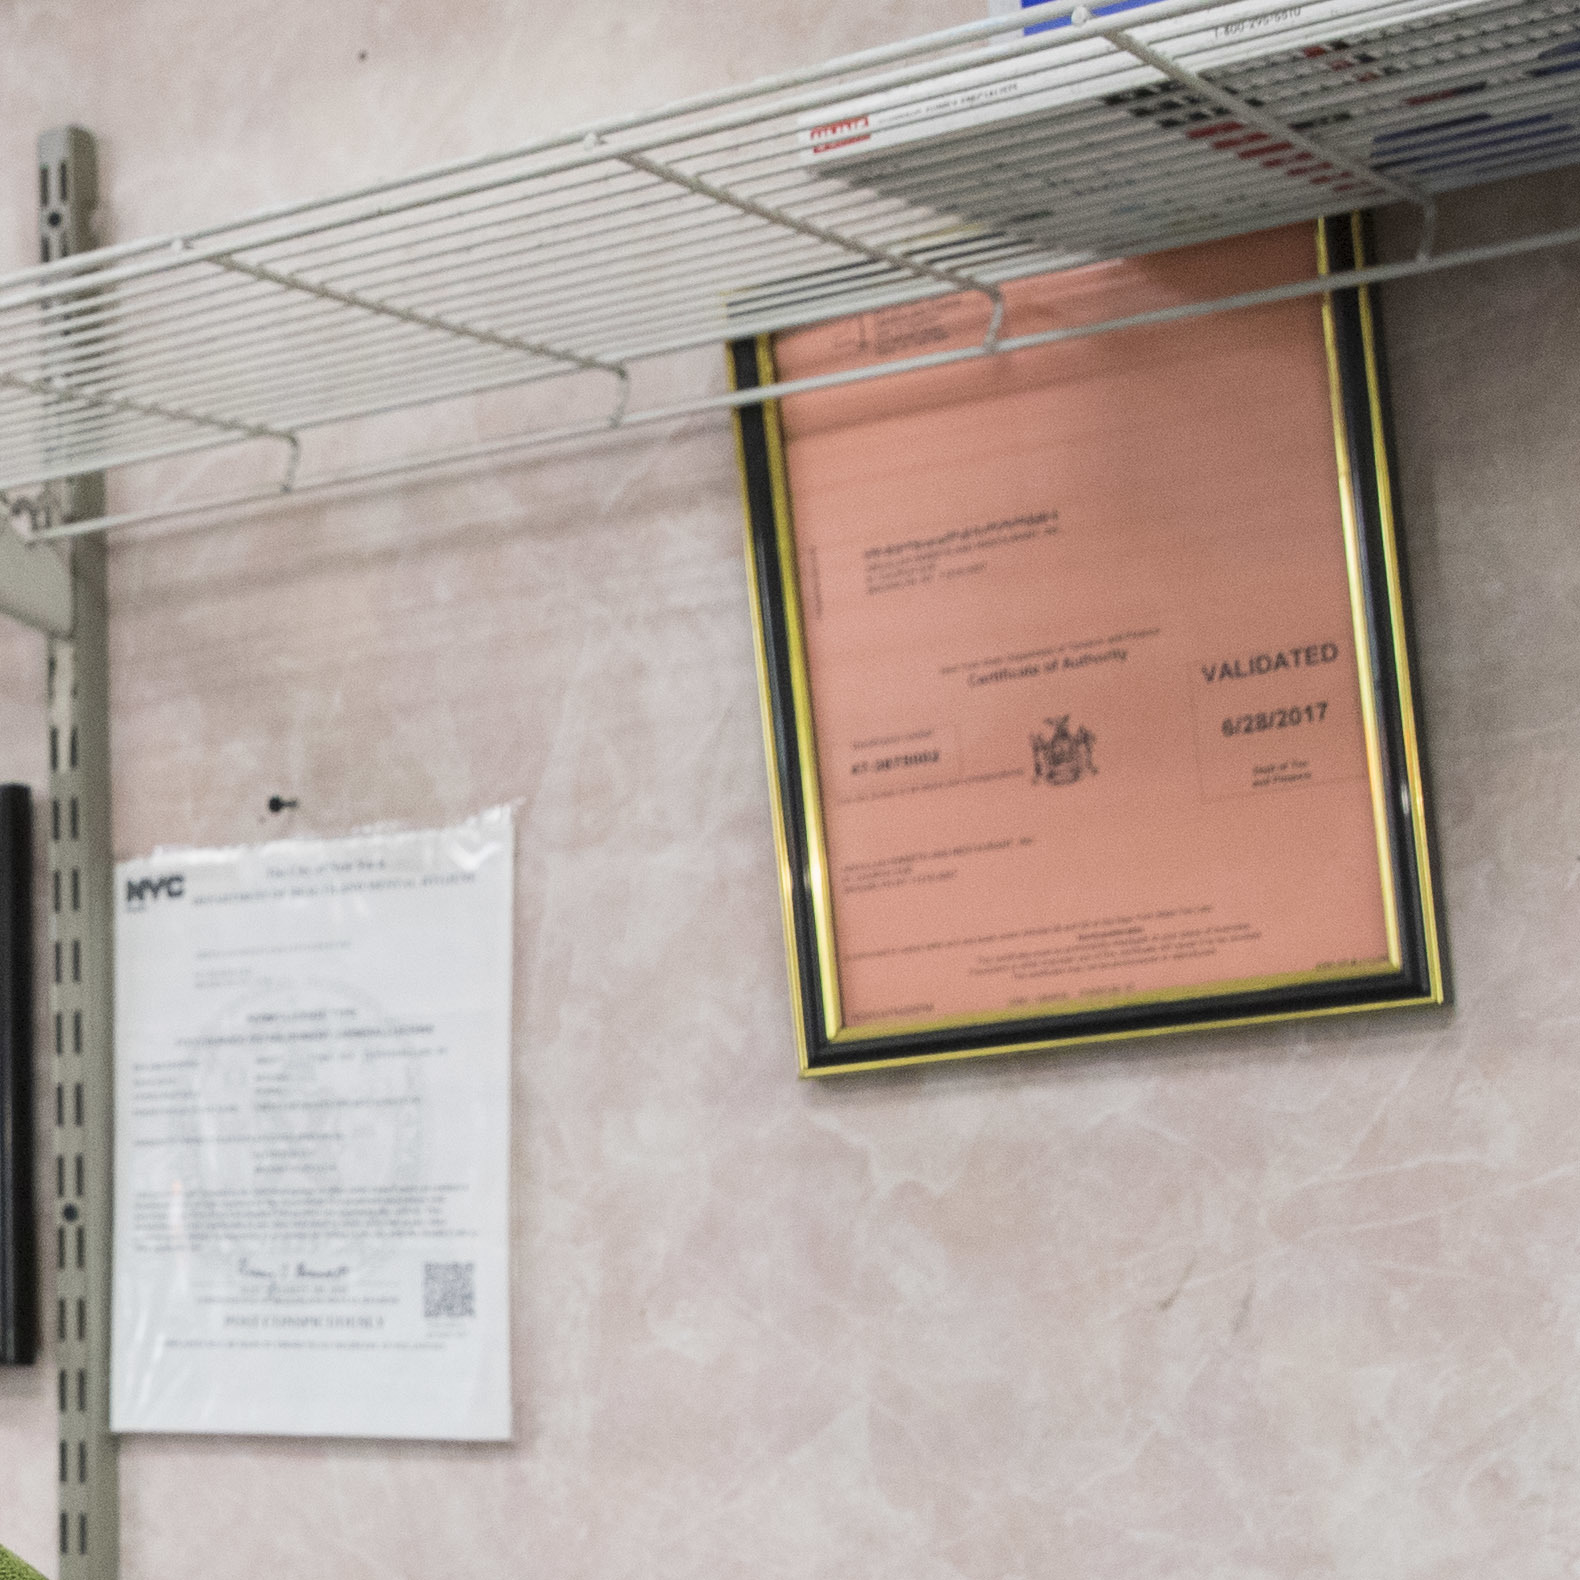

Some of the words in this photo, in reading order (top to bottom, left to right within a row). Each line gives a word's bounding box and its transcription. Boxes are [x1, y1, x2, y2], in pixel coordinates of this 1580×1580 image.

[1200, 642, 1340, 684] VALIDATED
[1220, 701, 1329, 738] 6/28/2017
[125, 874, 185, 905] NYC
